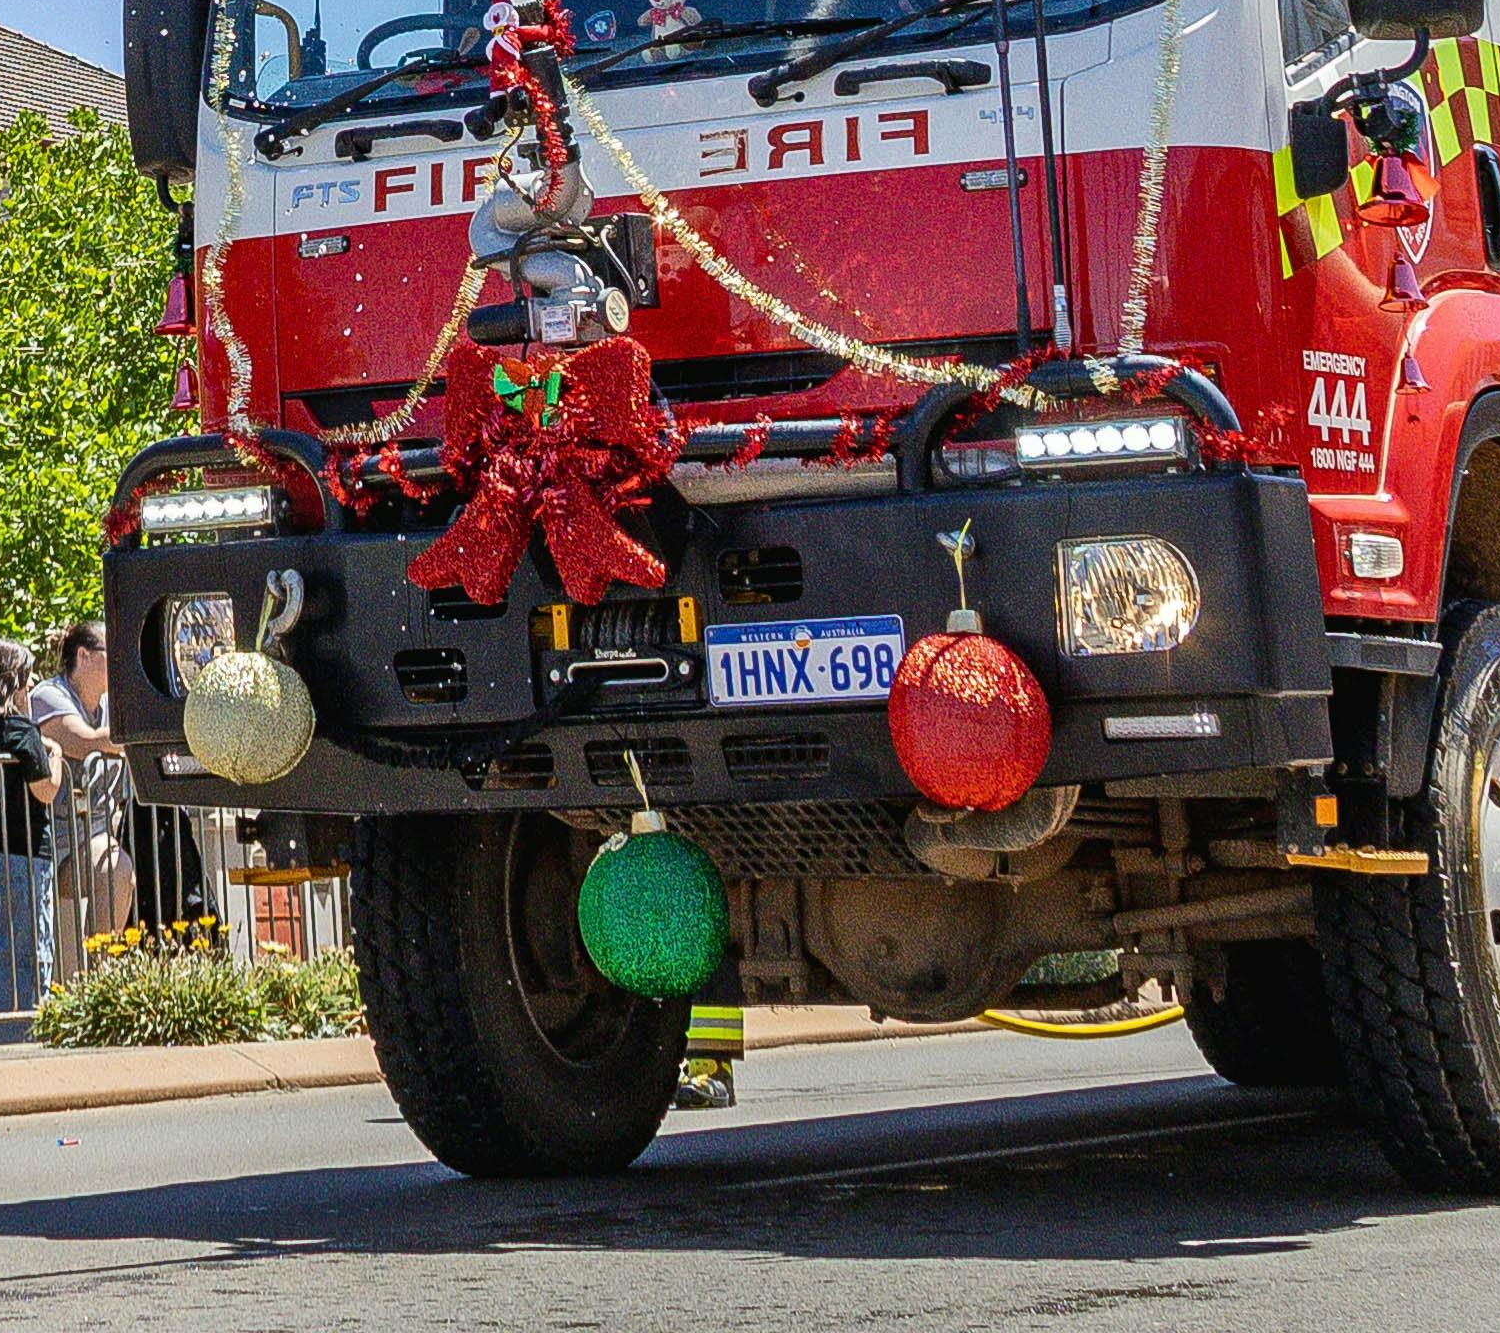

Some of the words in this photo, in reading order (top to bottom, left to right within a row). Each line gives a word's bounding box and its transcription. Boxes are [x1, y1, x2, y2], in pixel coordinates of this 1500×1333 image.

[291, 180, 361, 209] FTS
[374, 156, 513, 213] FIR
[1302, 349, 1366, 378] EMERGENCY
[1307, 377, 1372, 446] 444
[1310, 446, 1336, 469] 1800
[1335, 448, 1358, 472] NGF
[1358, 452, 1375, 474] 444
[741, 632, 784, 642] WESTERN
[820, 627, 866, 638] AUSTRALIA
